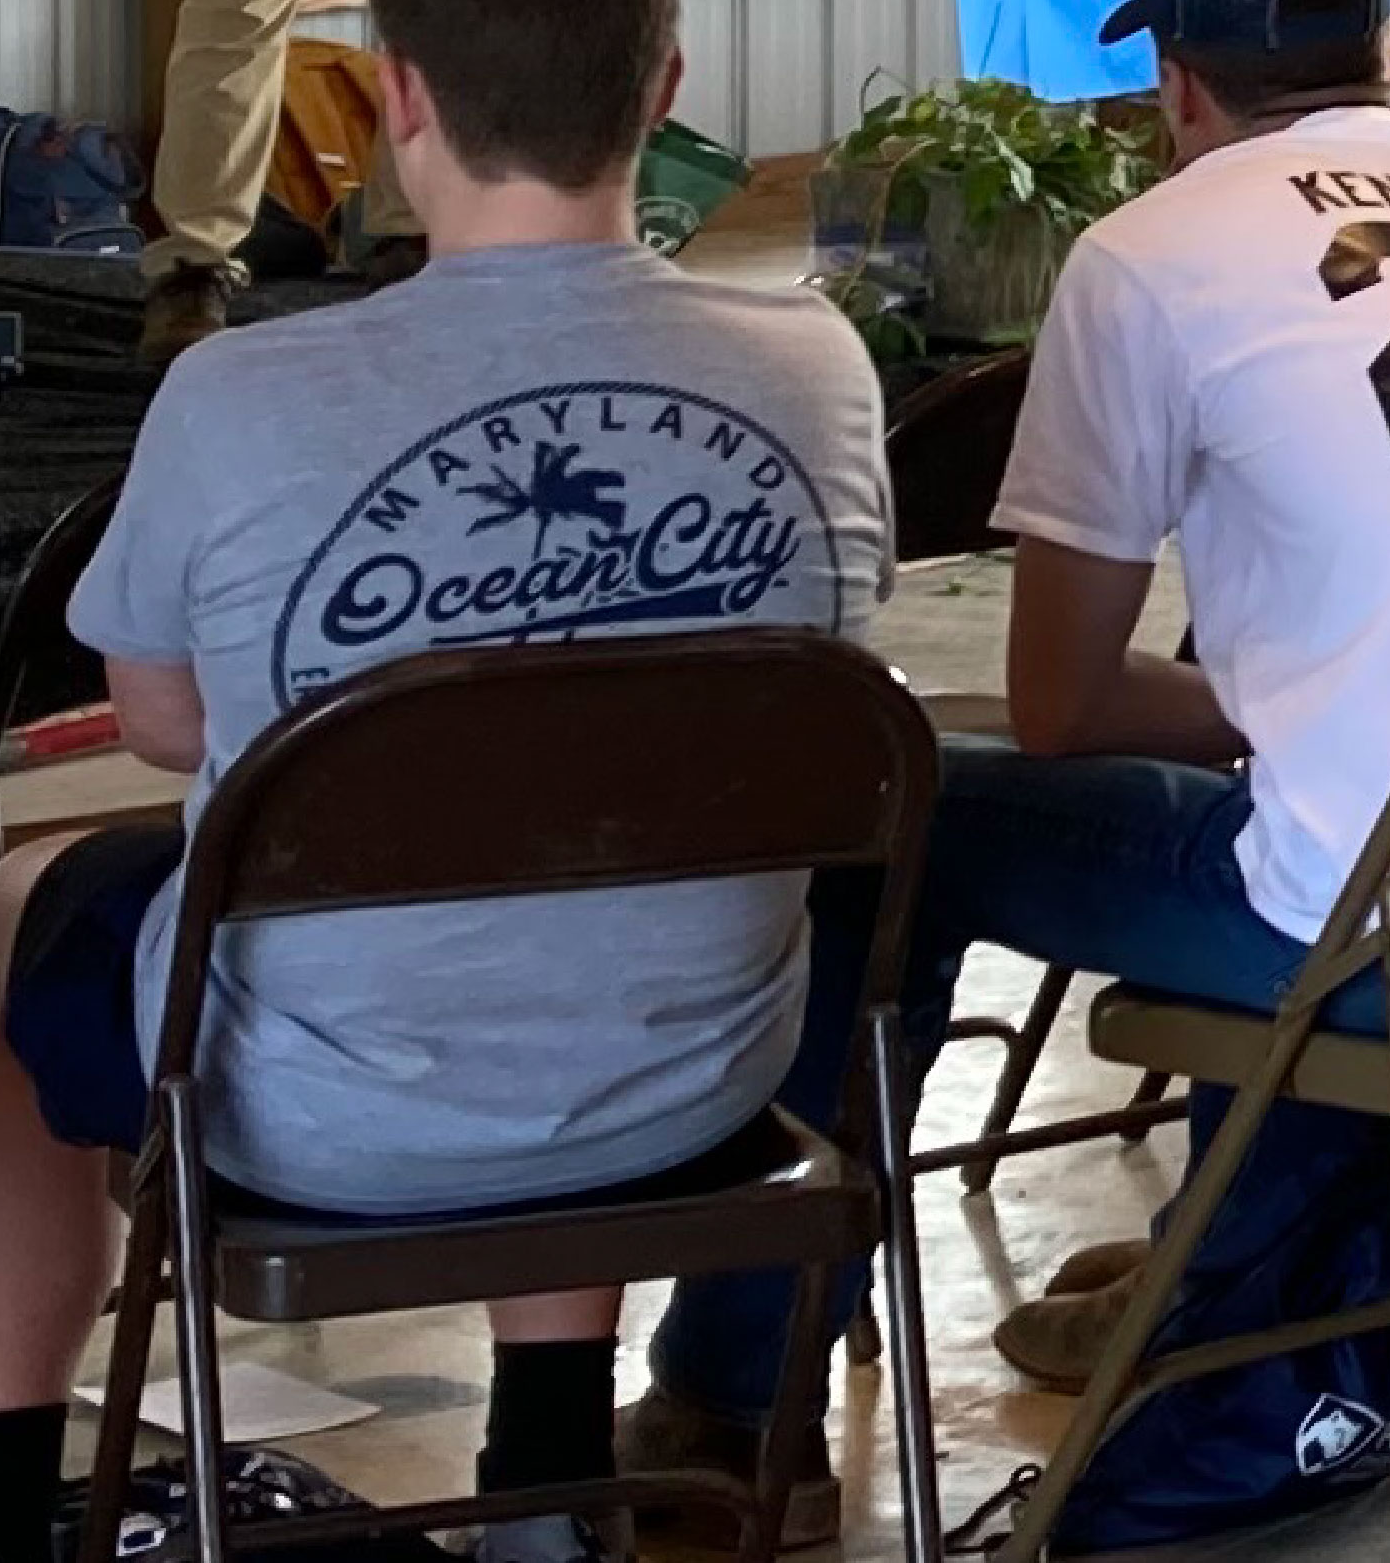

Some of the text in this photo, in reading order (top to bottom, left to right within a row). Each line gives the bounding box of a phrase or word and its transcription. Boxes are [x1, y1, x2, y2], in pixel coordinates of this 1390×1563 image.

[365, 396, 787, 534] MARYLAND
[320, 493, 801, 646] Ocean City
